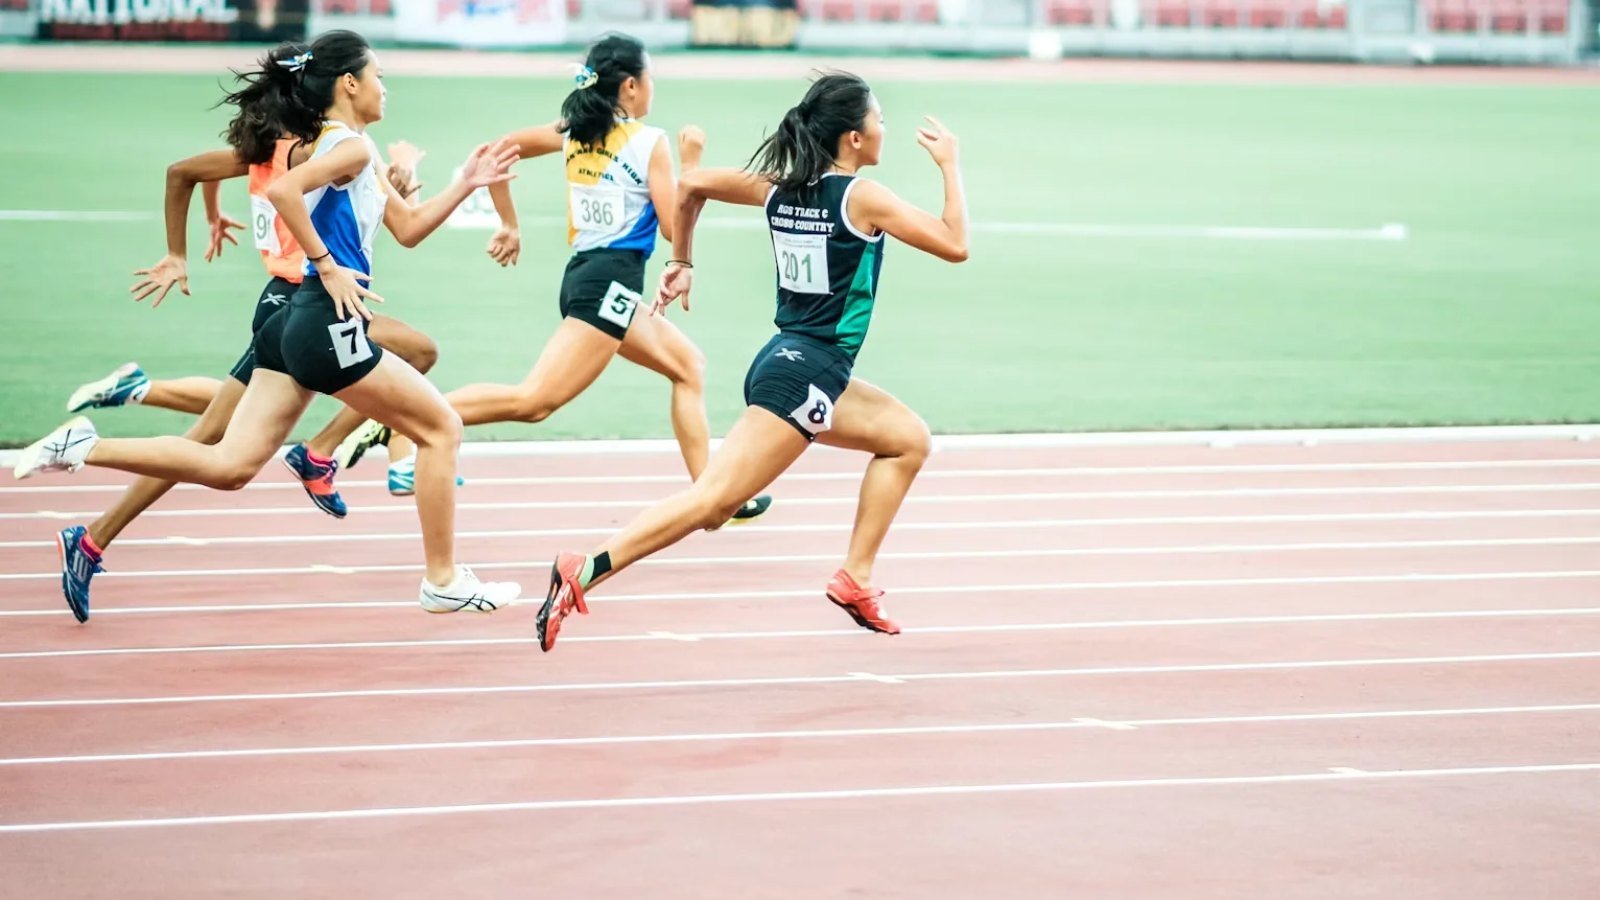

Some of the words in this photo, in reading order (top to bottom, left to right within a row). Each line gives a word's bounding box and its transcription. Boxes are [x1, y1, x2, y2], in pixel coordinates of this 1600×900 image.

[581, 198, 613, 226] 386
[777, 204, 794, 215] RGS
[794, 206, 820, 219] TRACK
[782, 250, 812, 283] 201
[611, 291, 630, 315] 5
[341, 326, 358, 356] 7
[808, 398, 828, 424] 8
